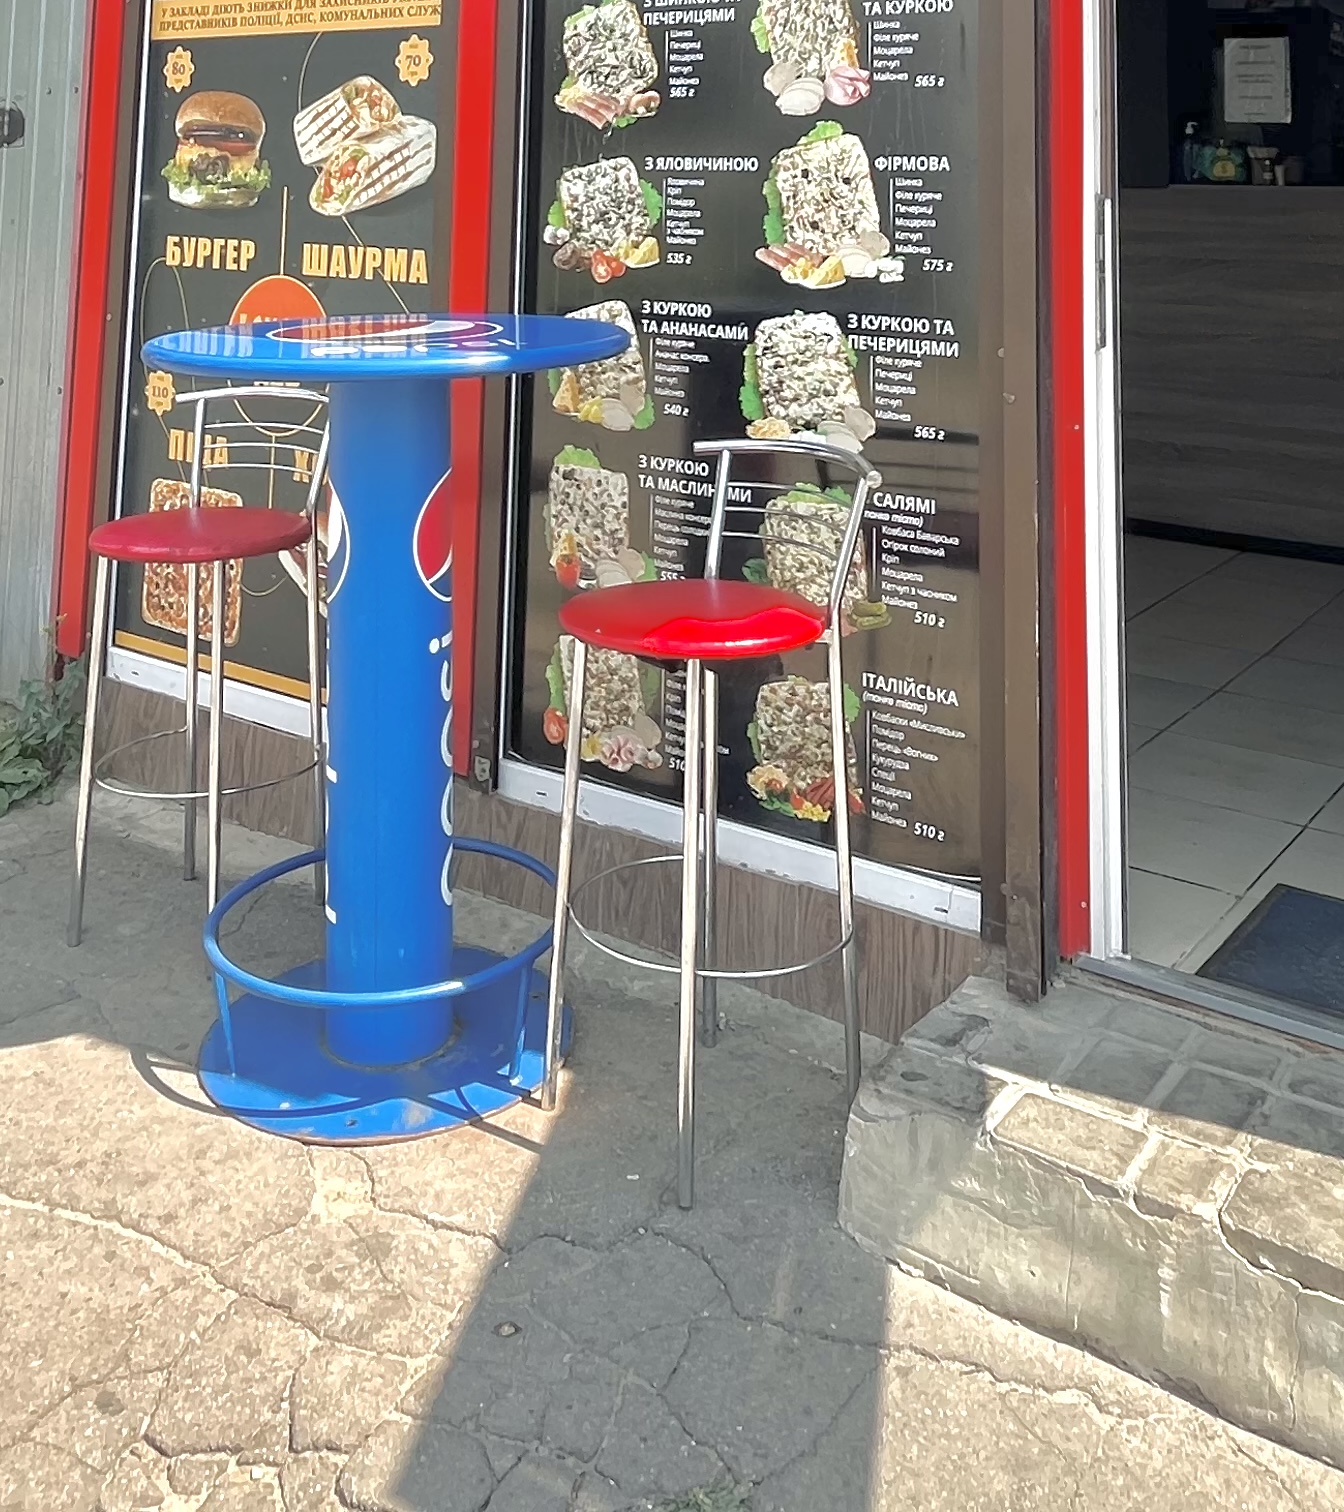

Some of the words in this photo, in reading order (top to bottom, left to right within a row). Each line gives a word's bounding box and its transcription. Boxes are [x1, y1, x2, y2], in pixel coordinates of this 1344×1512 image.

[169, 6, 210, 18] ЗАКЛАДІ
[212, 3, 245, 16] ДІЮТЬ
[247, 0, 292, 12] ЗНИЖКИ
[643, 8, 734, 26] ПЕЧЕРИЦЯМИ
[862, 2, 882, 16] ТА
[160, 17, 238, 32] ПРЕДСТАВНИКІВ
[319, 6, 404, 22] КОМУНАЛЬНИХ
[172, 61, 185, 76] 80
[405, 54, 422, 70] 70
[915, 75, 935, 87] 565
[645, 157, 653, 170] З
[656, 157, 758, 171] ЯЛОВИЧИНОЮ
[875, 156, 950, 172] ФІРМОВА
[165, 235, 256, 272] БУРГЕР
[301, 242, 429, 284] ШАУРМА
[923, 259, 944, 270] 575
[642, 300, 650, 314] З
[654, 302, 712, 318] КУРКОЮ
[641, 320, 657, 333] ТА
[847, 314, 858, 328] З
[861, 315, 930, 333] КУРКОЮ
[934, 319, 954, 335] ТА
[847, 335, 958, 358] ПЕЧЕРИЦЯМИ
[152, 384, 169, 399] 110
[664, 404, 681, 415] 540
[914, 426, 936, 439] 565
[639, 455, 647, 468] З
[651, 457, 709, 476] КУРКОЮ
[638, 475, 655, 488] ТА
[658, 477, 752, 503] МАСЛИНМИ
[873, 492, 935, 514] САЛЯМІ
[914, 611, 936, 626] 510
[862, 673, 959, 706] ІТАЛІЙСЬКА
[914, 822, 936, 838] 510
